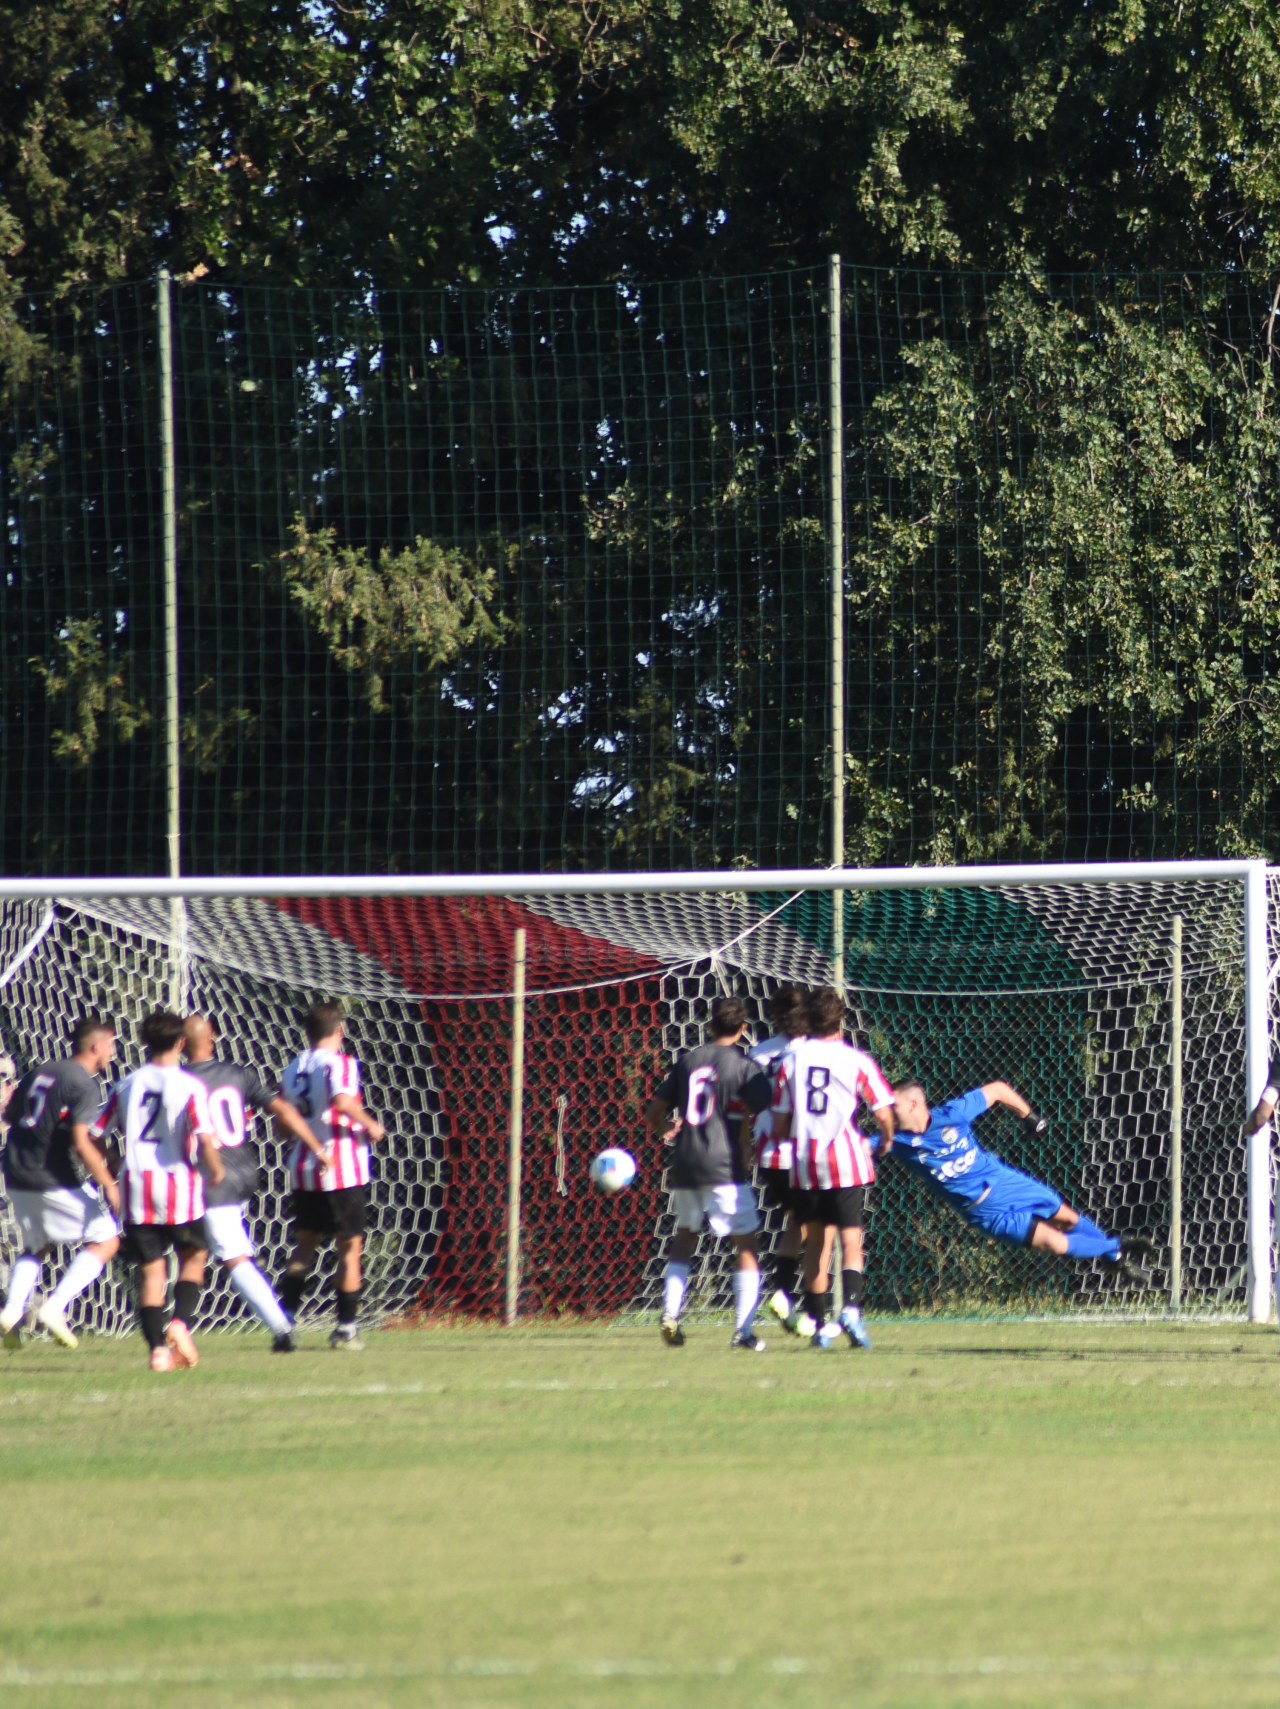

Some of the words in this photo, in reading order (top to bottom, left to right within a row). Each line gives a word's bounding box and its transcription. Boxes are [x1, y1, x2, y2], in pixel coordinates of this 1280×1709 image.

[19, 1074, 56, 1129] 5
[139, 1091, 163, 1144] 2
[208, 1086, 245, 1149] 0
[686, 1066, 718, 1126] 6
[806, 1066, 830, 1115] 8
